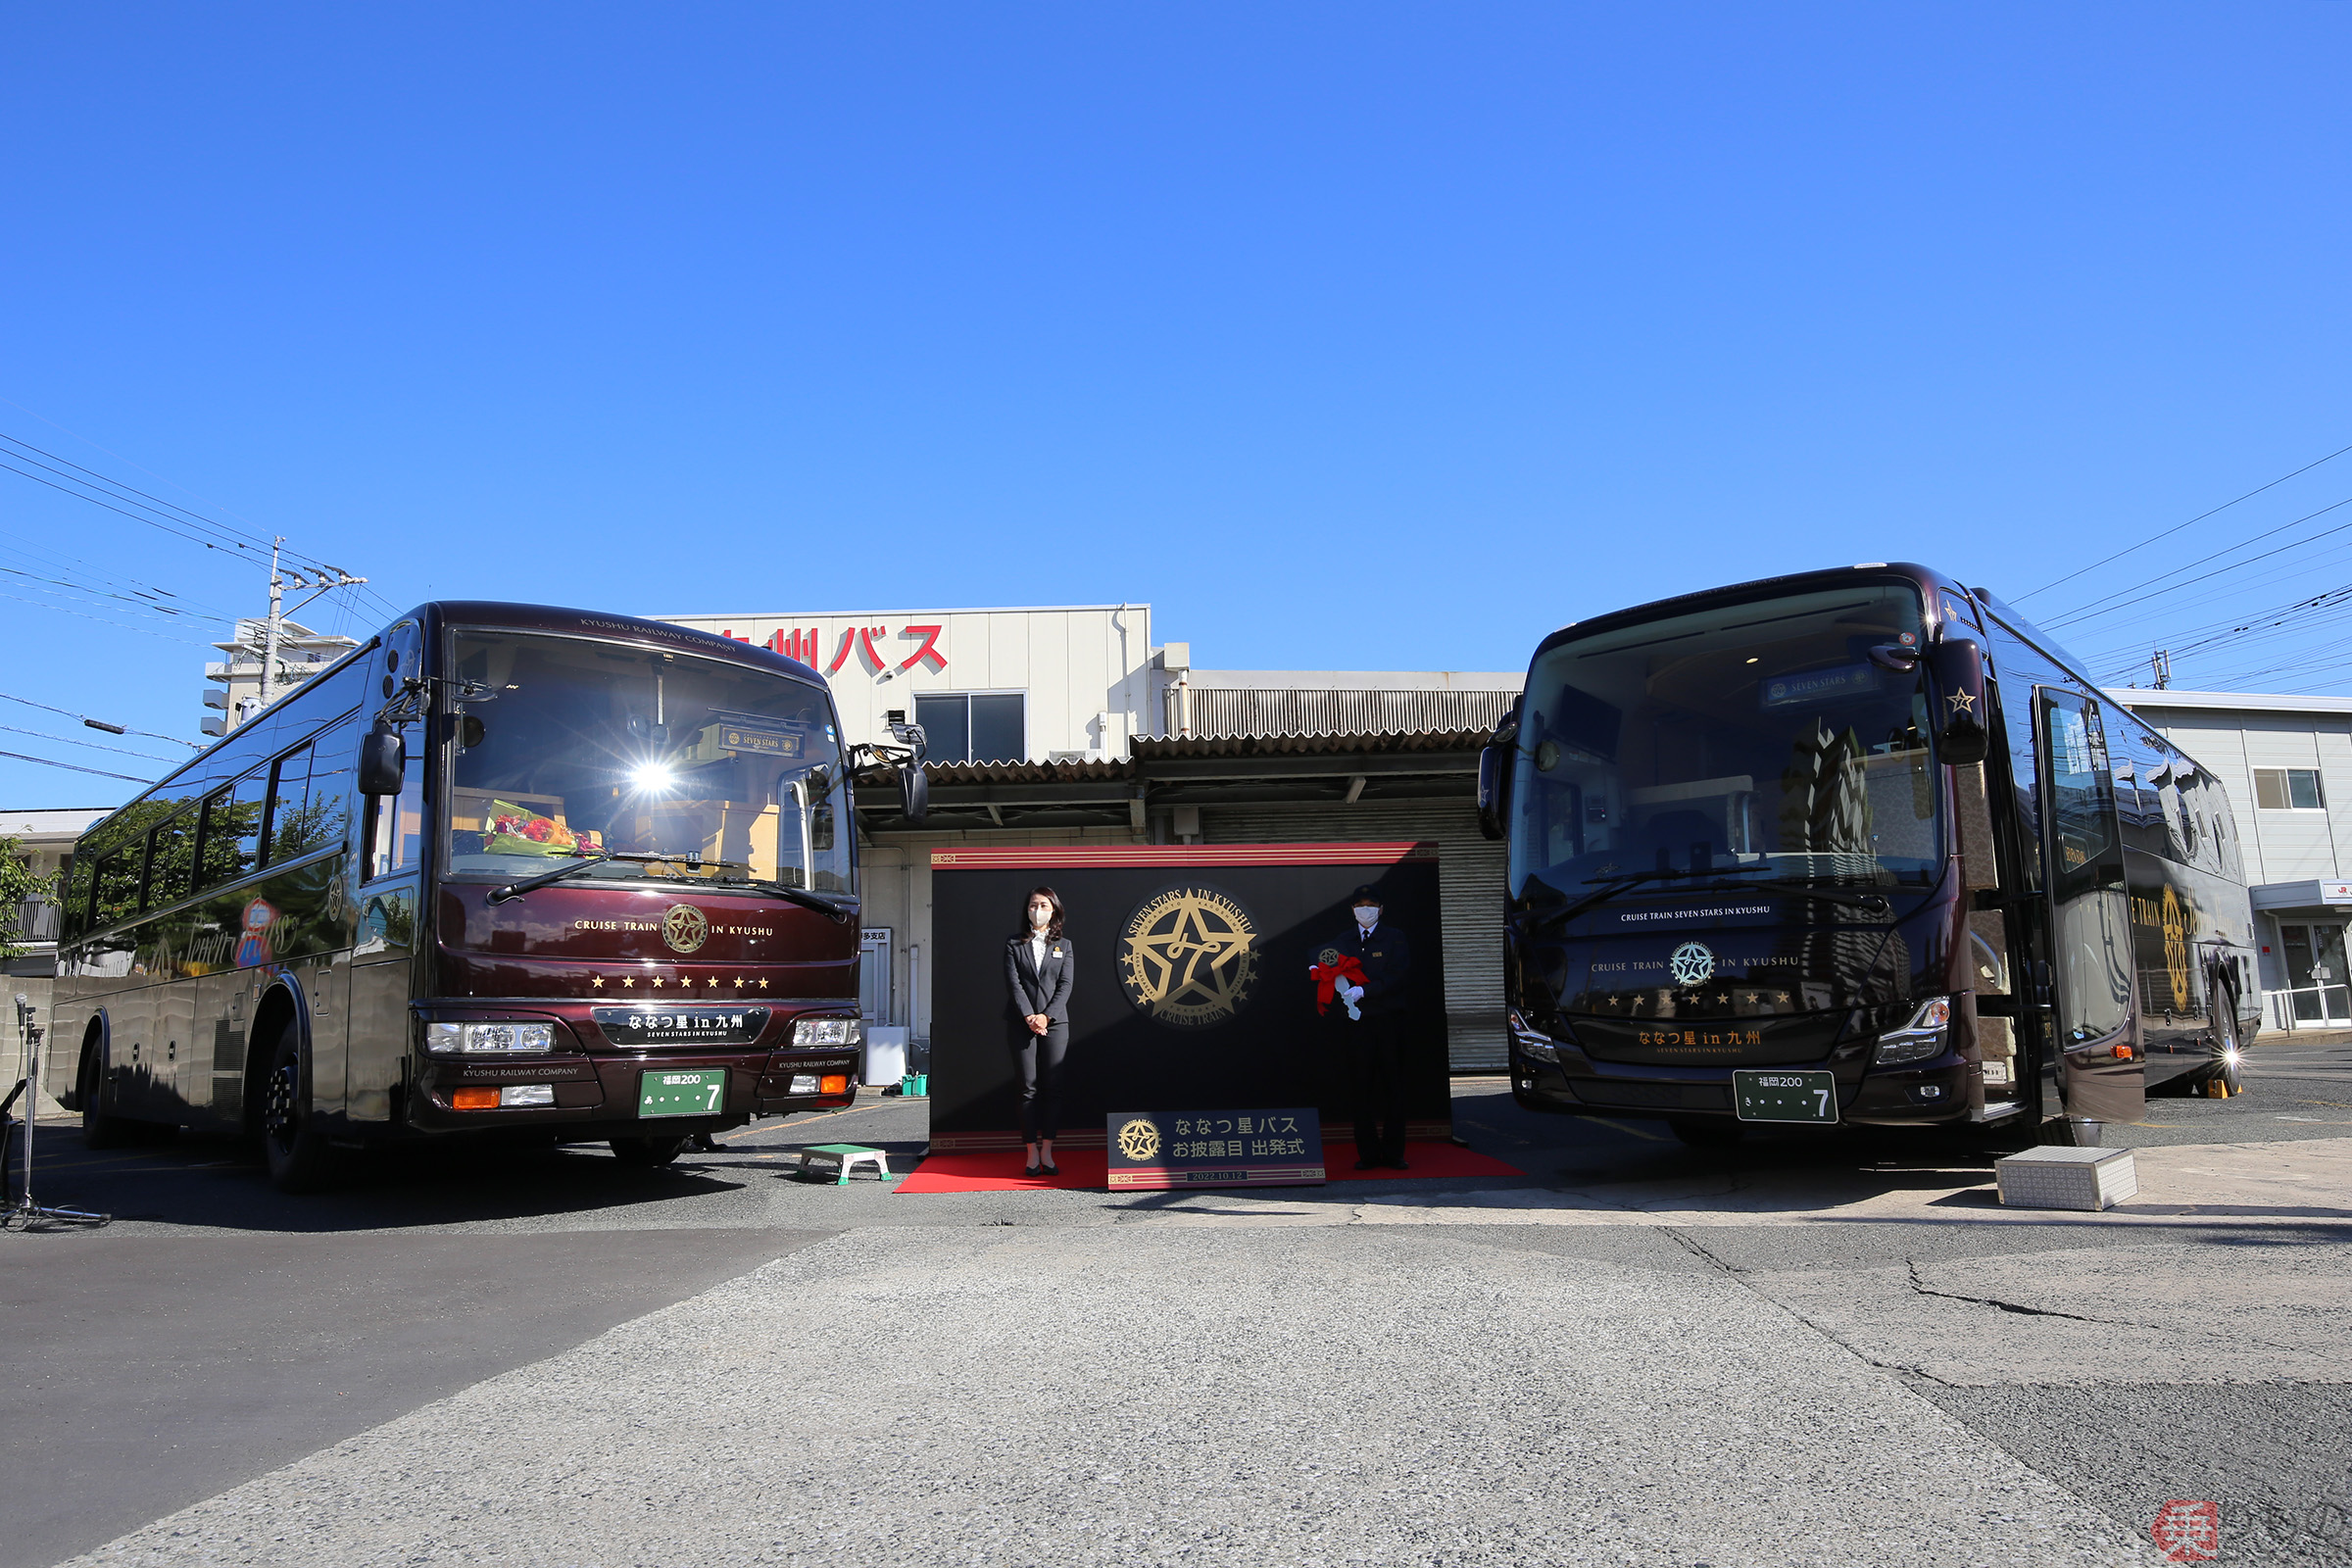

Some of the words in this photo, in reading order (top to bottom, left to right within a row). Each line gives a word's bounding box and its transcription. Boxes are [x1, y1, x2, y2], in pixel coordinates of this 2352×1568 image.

[580, 618, 629, 631] KYUSHU
[633, 624, 682, 641] RAILWAY
[686, 635, 736, 653] COMPANY
[1791, 681, 1819, 692] SEVEN
[1820, 676, 1846, 687] STARS
[743, 736, 761, 746] SEVEN
[761, 738, 779, 748] STARS
[1128, 906, 1153, 935] SEVEN
[1151, 889, 1182, 909] STARS
[1198, 888, 1211, 900] IN
[1213, 893, 1253, 932] KYUSHU
[1199, 902, 1241, 932] KAGOSHIMA
[1621, 912, 1648, 922] CRUISE
[1649, 911, 1673, 920] TRAIN
[1674, 909, 1698, 918] SEVEN
[1699, 907, 1723, 917] STARS
[1736, 906, 1771, 915] KYUSHU
[2137, 898, 2161, 928] TRAIN
[1141, 902, 1182, 935] KUMAMOTO
[574, 919, 617, 931] CRUISE
[624, 921, 658, 932] TRAIN
[711, 925, 723, 934] IN
[729, 926, 773, 937] KYUSHU
[860, 931, 886, 941] 多支店
[1592, 961, 1627, 972] CRUISE
[1633, 960, 1664, 970] TRAIN
[1722, 957, 1736, 967] IN
[1743, 956, 1799, 967] KYUSHU
[1169, 1004, 1216, 1013] FUKUOKA
[628, 1014, 689, 1030] ななつ星
[694, 1014, 710, 1029] in
[715, 1013, 743, 1029] 九州
[1159, 1008, 1194, 1026] CRUISE
[1197, 1007, 1227, 1026] TRAIN
[1639, 1030, 1696, 1046] ななつ星
[1703, 1032, 1721, 1045] in
[1727, 1030, 1762, 1046] 九州
[779, 1060, 803, 1069] KYUSHU
[803, 1059, 826, 1068] RAILWAY
[538, 1067, 578, 1076] COMPANY
[662, 1074, 701, 1085] 福岡200
[1758, 1076, 1803, 1088] 福岡200
[1172, 1140, 1244, 1158] お披露目
[1251, 1138, 1305, 1156] 出発式
[1192, 1171, 1243, 1181] 2022.10.12
